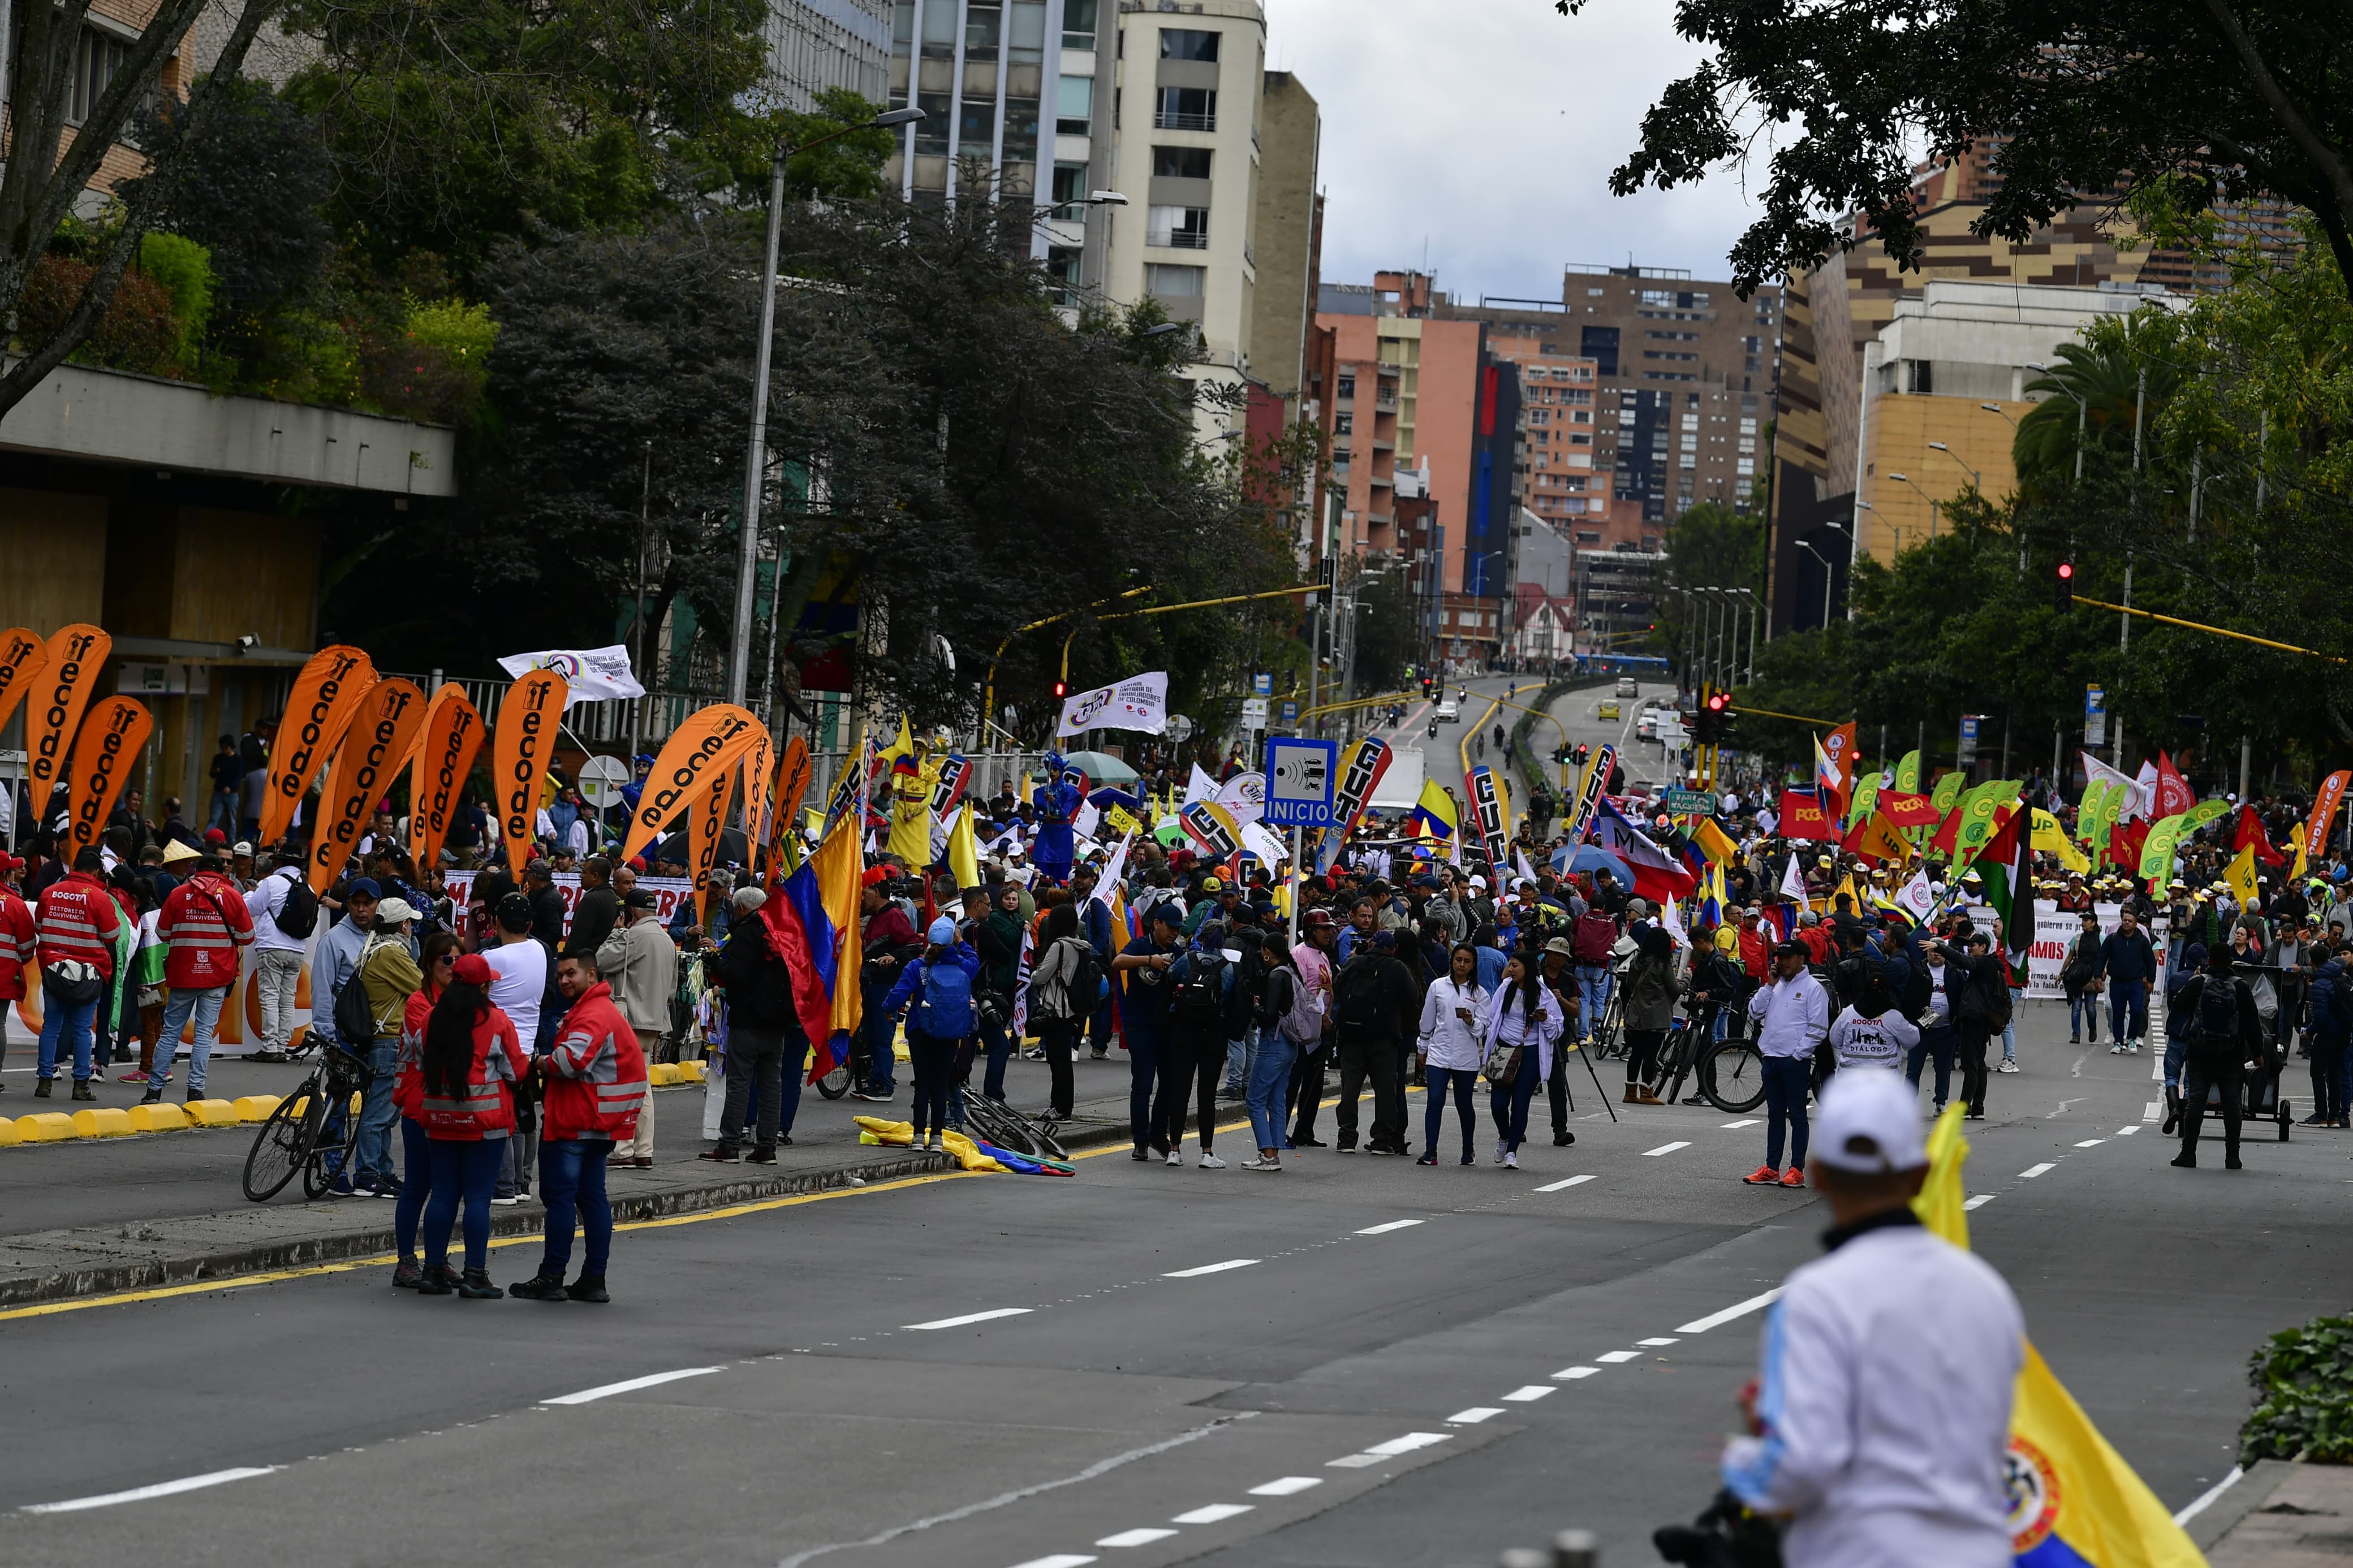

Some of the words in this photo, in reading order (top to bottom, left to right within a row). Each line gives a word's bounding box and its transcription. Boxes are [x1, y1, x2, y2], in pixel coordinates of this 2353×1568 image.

[33, 635, 95, 780] fecode
[281, 658, 358, 797] fecode
[1118, 692, 1161, 703] TRABAJADORES
[1126, 697, 1155, 707] COLOMBIA
[74, 710, 138, 844] fecode
[336, 692, 412, 844] fecode
[429, 712, 473, 833] fecode
[508, 681, 551, 839] fecode
[641, 720, 749, 828] fecode
[1333, 742, 1382, 823] CUT
[1576, 748, 1611, 830] CUT
[695, 772, 726, 891] ecode
[1261, 835, 1285, 858] COMUN
[1268, 801, 1329, 822] INICIO
[1475, 772, 1506, 863] CUT
[1882, 831, 1900, 854] UP
[1963, 797, 1996, 866] CGT
[2145, 835, 2173, 896] CGT
[49, 912, 85, 921] CONVIVENCIA
[50, 906, 77, 914] GESTORES
[2037, 921, 2063, 930] gobierno
[2028, 941, 2065, 960] AMOS
